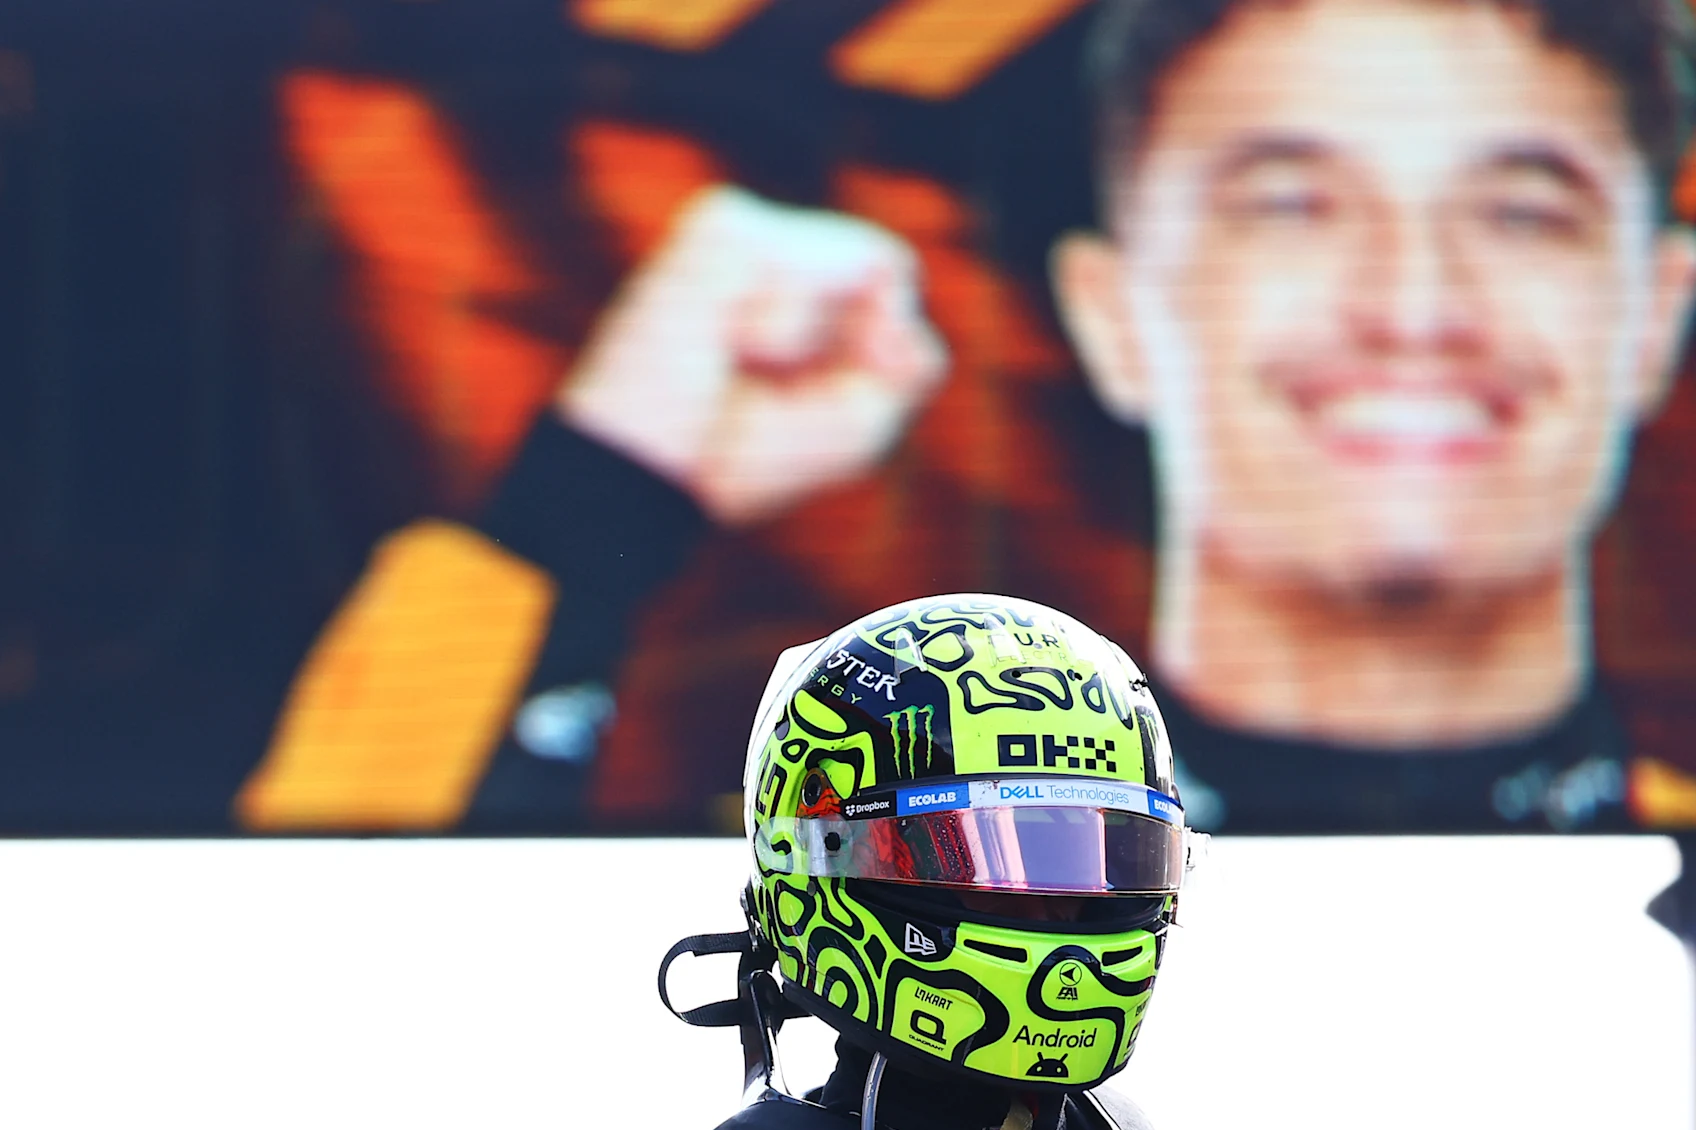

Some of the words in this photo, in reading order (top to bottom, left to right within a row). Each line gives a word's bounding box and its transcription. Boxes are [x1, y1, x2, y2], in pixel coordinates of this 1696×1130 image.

[826, 649, 898, 700] STER
[997, 734, 1116, 773] OKX
[908, 792, 956, 807] ECOLAB
[1000, 786, 1044, 800] DELL
[1047, 785, 1130, 805] Technologies
[856, 800, 890, 813] Dropbox
[1013, 1025, 1097, 1048] Android
